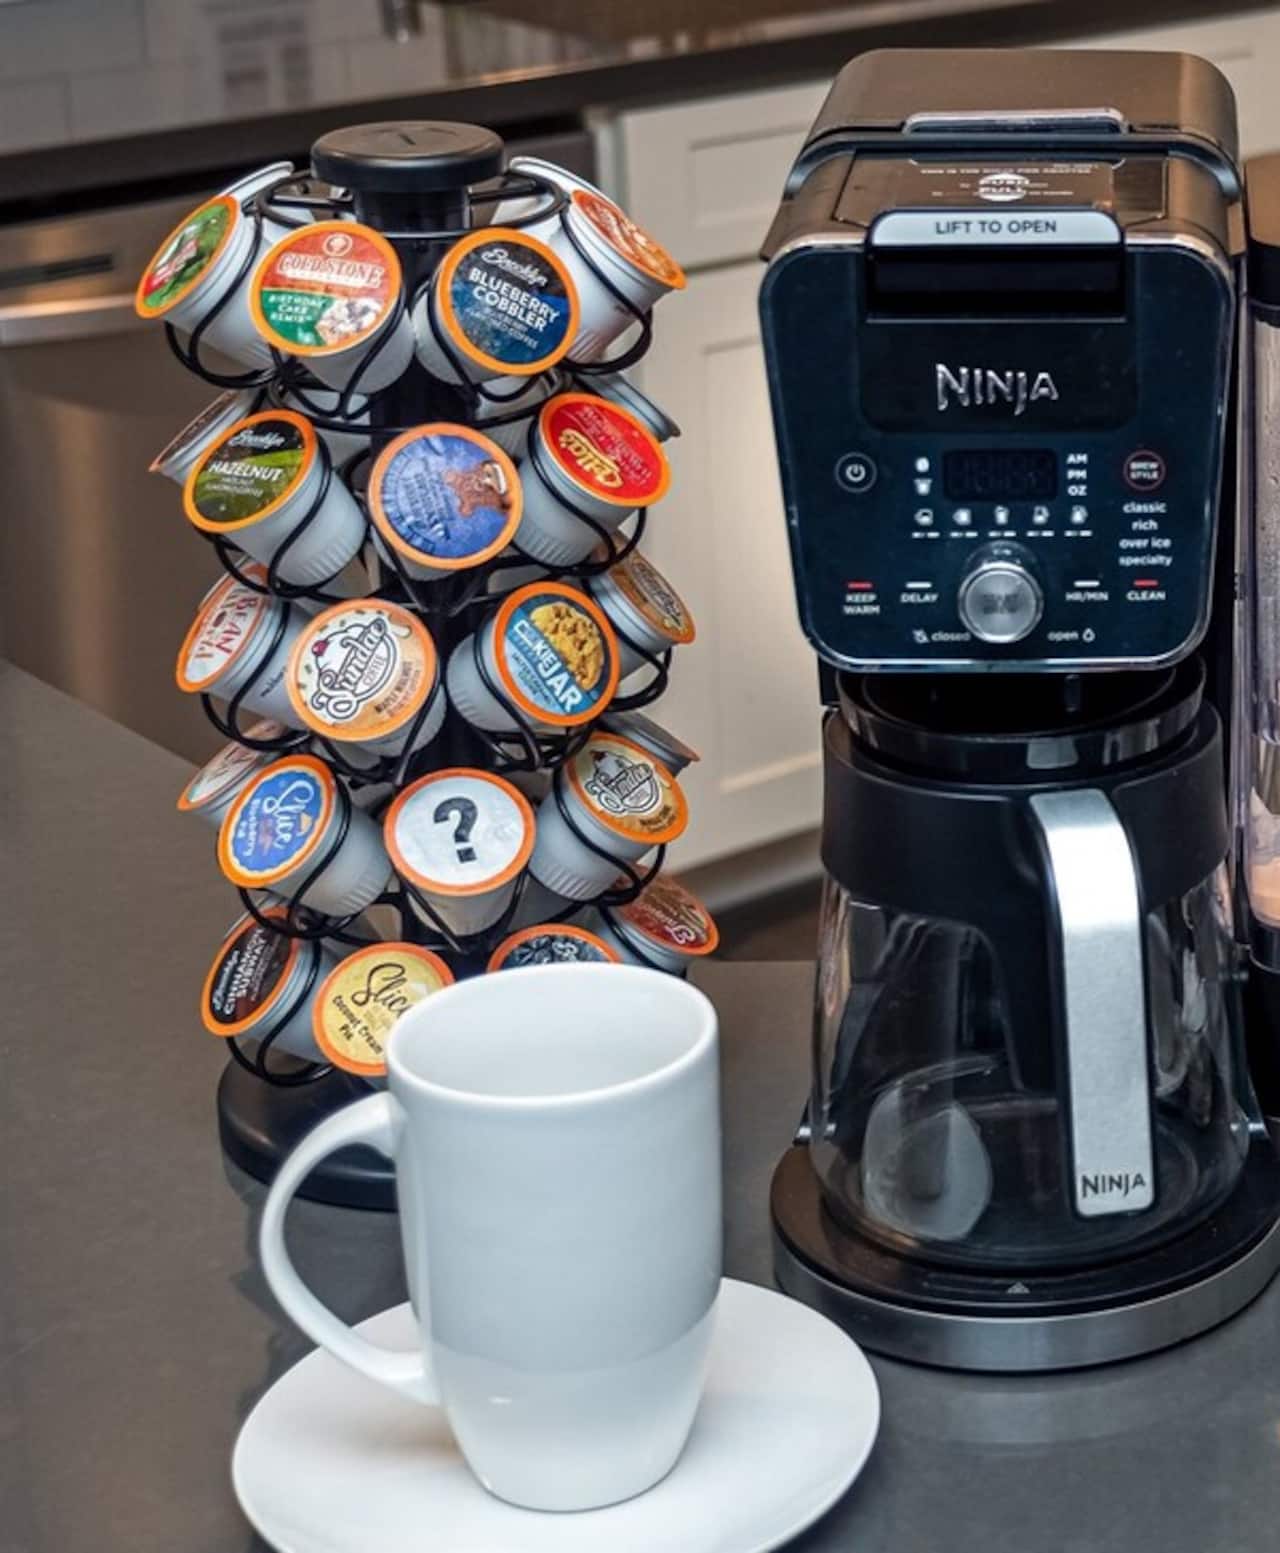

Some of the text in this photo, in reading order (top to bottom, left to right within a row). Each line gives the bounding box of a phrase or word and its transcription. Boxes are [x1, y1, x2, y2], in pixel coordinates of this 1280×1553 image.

[935, 220, 1056, 234] LIFT TO OPEN
[481, 248, 549, 287] Brooklyn
[325, 259, 385, 289] STONE
[468, 267, 560, 324] BLUEBERRY
[277, 303, 308, 315] CAKE
[472, 286, 548, 332] COBBLER
[936, 363, 1059, 416] NINJA
[1066, 453, 1088, 464] AM
[208, 460, 283, 482] HAZELNUT
[1067, 469, 1087, 480] PM
[1067, 485, 1087, 496] OZ
[1123, 501, 1167, 513] classic
[1131, 519, 1158, 531] rich
[1119, 537, 1171, 549] over ice
[1119, 554, 1172, 567] specialty
[845, 593, 877, 603] KEEP
[900, 593, 939, 603] DELAY
[1065, 591, 1109, 602] HR/MIN
[1126, 591, 1166, 601] CLEAN
[843, 604, 880, 615] WARM
[931, 631, 971, 641] closed
[1047, 631, 1079, 642] open
[262, 779, 315, 850] Slice
[432, 796, 479, 864] ?
[332, 994, 362, 1029] Coconut
[357, 1025, 384, 1055] Cream
[339, 1023, 354, 1041] Pie
[1081, 1172, 1147, 1199] NINJA
